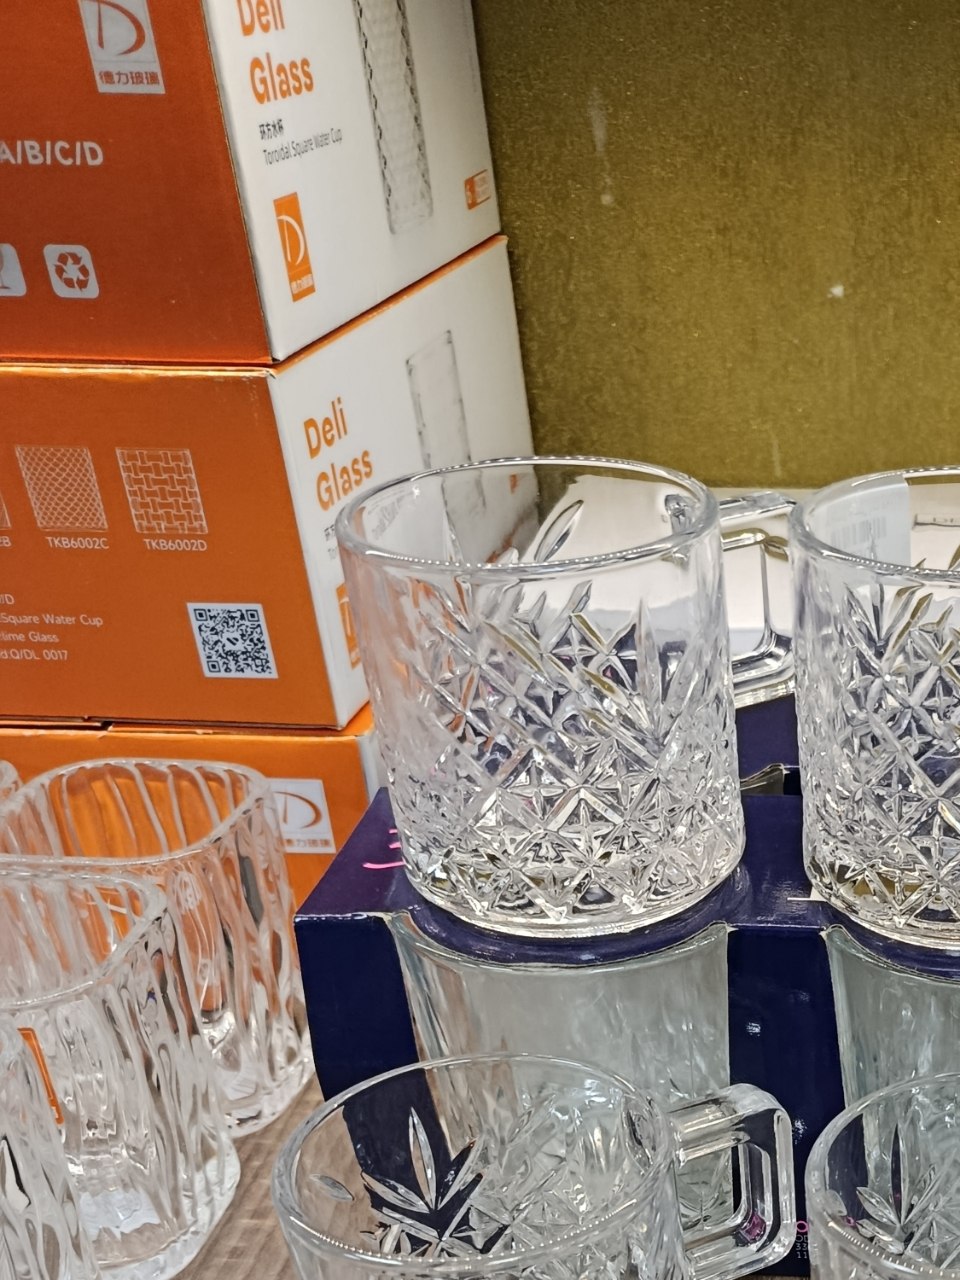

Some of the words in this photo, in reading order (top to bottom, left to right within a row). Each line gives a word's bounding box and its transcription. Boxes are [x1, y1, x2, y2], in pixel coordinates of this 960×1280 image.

[99, 71, 160, 85] 德力玻璃
[249, 52, 314, 104] Glass
[263, 142, 292, 166] Toroidal
[292, 139, 314, 158] Square
[331, 127, 343, 144] Cup
[303, 397, 347, 459] Deli
[315, 449, 374, 512] Glass
[46, 536, 109, 549] TKB6002C
[144, 538, 208, 551] TKB6002D
[42, 614, 76, 625] Water
[80, 615, 103, 627] Cup
[28, 631, 59, 643] Glass
[43, 650, 68, 660] 0017
